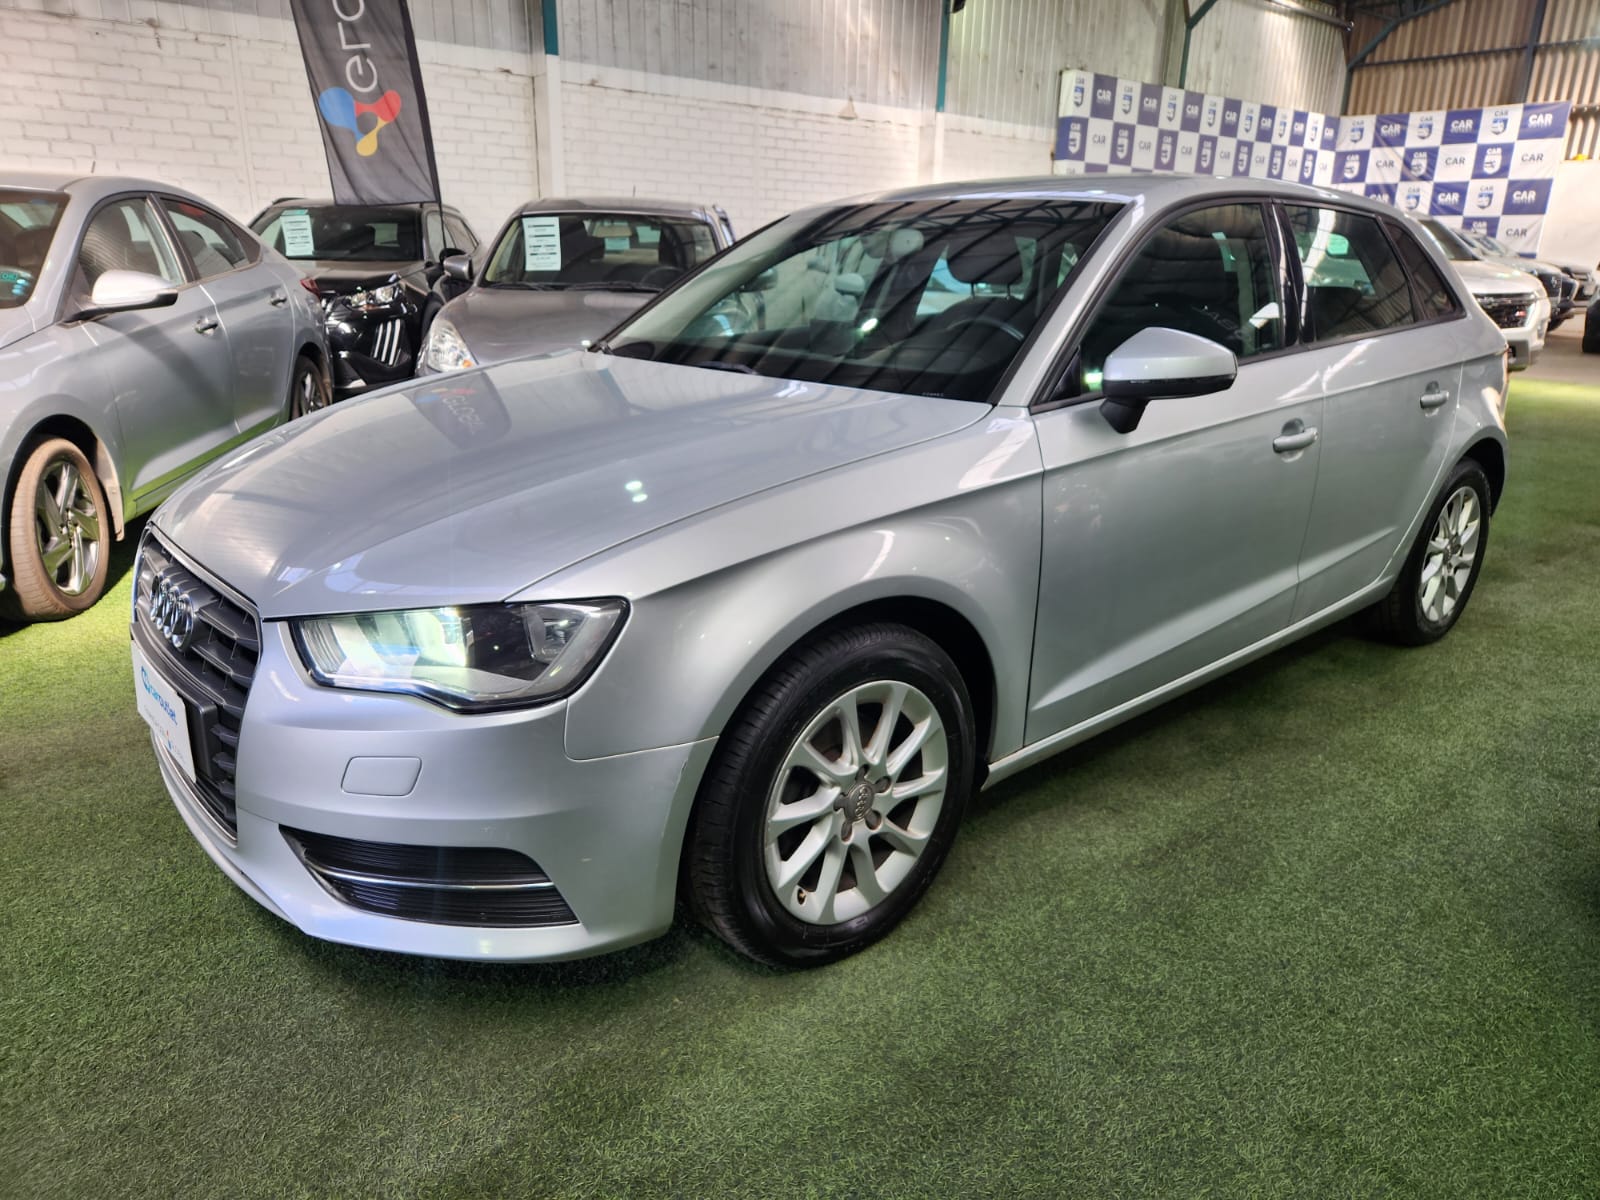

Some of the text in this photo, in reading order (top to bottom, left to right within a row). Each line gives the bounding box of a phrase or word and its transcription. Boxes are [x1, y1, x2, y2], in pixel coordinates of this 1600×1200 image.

[1097, 90, 1112, 100] CAR
[1144, 98, 1157, 107] CAR
[1187, 105, 1199, 115] CAR
[1225, 111, 1237, 121] CAR
[1529, 113, 1553, 123] CAR
[1381, 124, 1401, 132] CAR
[1451, 119, 1473, 128] CAR
[1092, 134, 1106, 145] CAR
[1138, 140, 1152, 151] CAR
[1181, 146, 1193, 155] CAR
[1219, 151, 1231, 160] CAR
[1521, 153, 1544, 162] CAR
[1376, 160, 1395, 168] CAR
[1445, 157, 1466, 166] CAR
[1438, 192, 1460, 202] CAR
[1513, 191, 1536, 200] CAR
[1506, 228, 1528, 237] CAR
